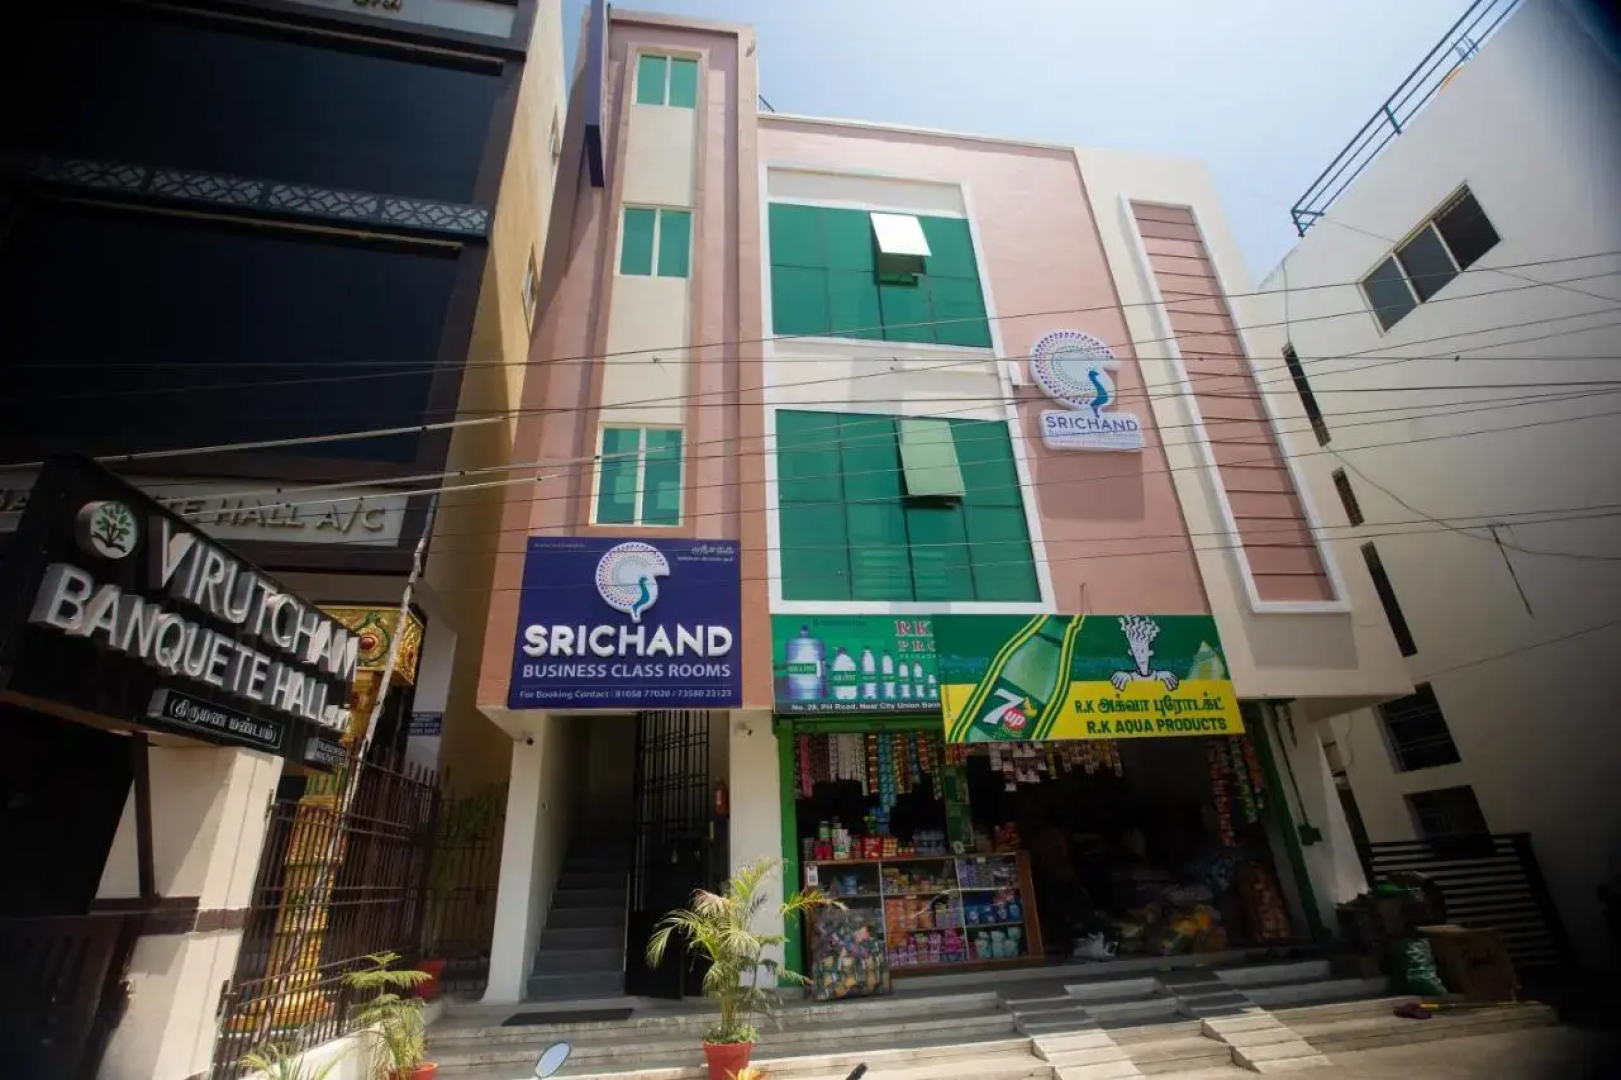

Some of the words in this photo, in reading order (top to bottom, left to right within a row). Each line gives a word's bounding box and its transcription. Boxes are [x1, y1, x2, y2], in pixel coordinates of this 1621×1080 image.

[1045, 416, 1138, 431] SRICHAND
[216, 499, 305, 529] HALL
[316, 502, 385, 534] A/C
[156, 516, 359, 683] VIRUTCHAM
[36, 563, 272, 702] BANQUETE
[267, 660, 329, 727] HALL
[522, 623, 733, 658] SRICHAND
[522, 663, 607, 678] BUSINESS
[611, 663, 664, 678] CLASS
[668, 663, 731, 678] ROOMS
[519, 690, 534, 699] For
[536, 690, 573, 700] Booking
[574, 690, 609, 699] Contact
[880, 702, 895, 711] City
[1086, 721, 1112, 734] R.K
[1115, 719, 1153, 734] AQUA
[1156, 717, 1227, 732] PRODUCTS
